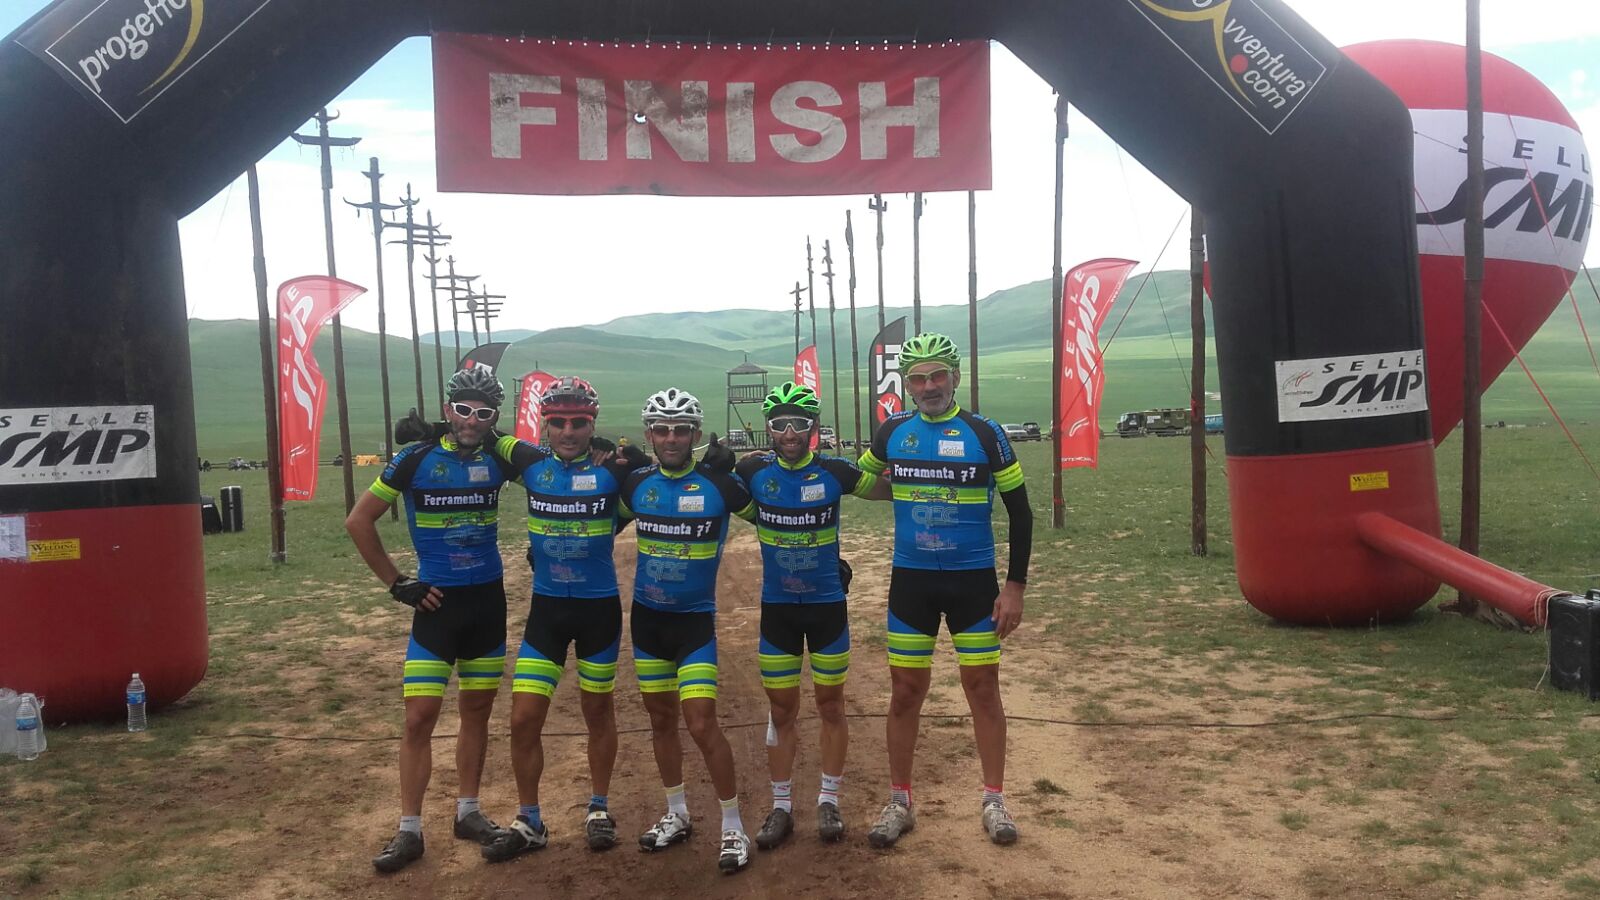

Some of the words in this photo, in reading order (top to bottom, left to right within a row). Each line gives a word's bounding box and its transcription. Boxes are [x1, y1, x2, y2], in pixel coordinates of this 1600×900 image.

[488, 72, 941, 164] FINISH
[1321, 355, 1422, 374] SELLE
[1299, 369, 1423, 408] SMP
[0, 412, 149, 428] SELLE
[0, 428, 151, 468] SMP
[894, 463, 955, 480] Ferramenta
[960, 466, 977, 482] 77
[423, 492, 485, 506] Ferramenta
[592, 497, 607, 515] 77
[820, 507, 833, 525] 77
[696, 520, 712, 538] 77
[31, 543, 77, 552] WELDING
